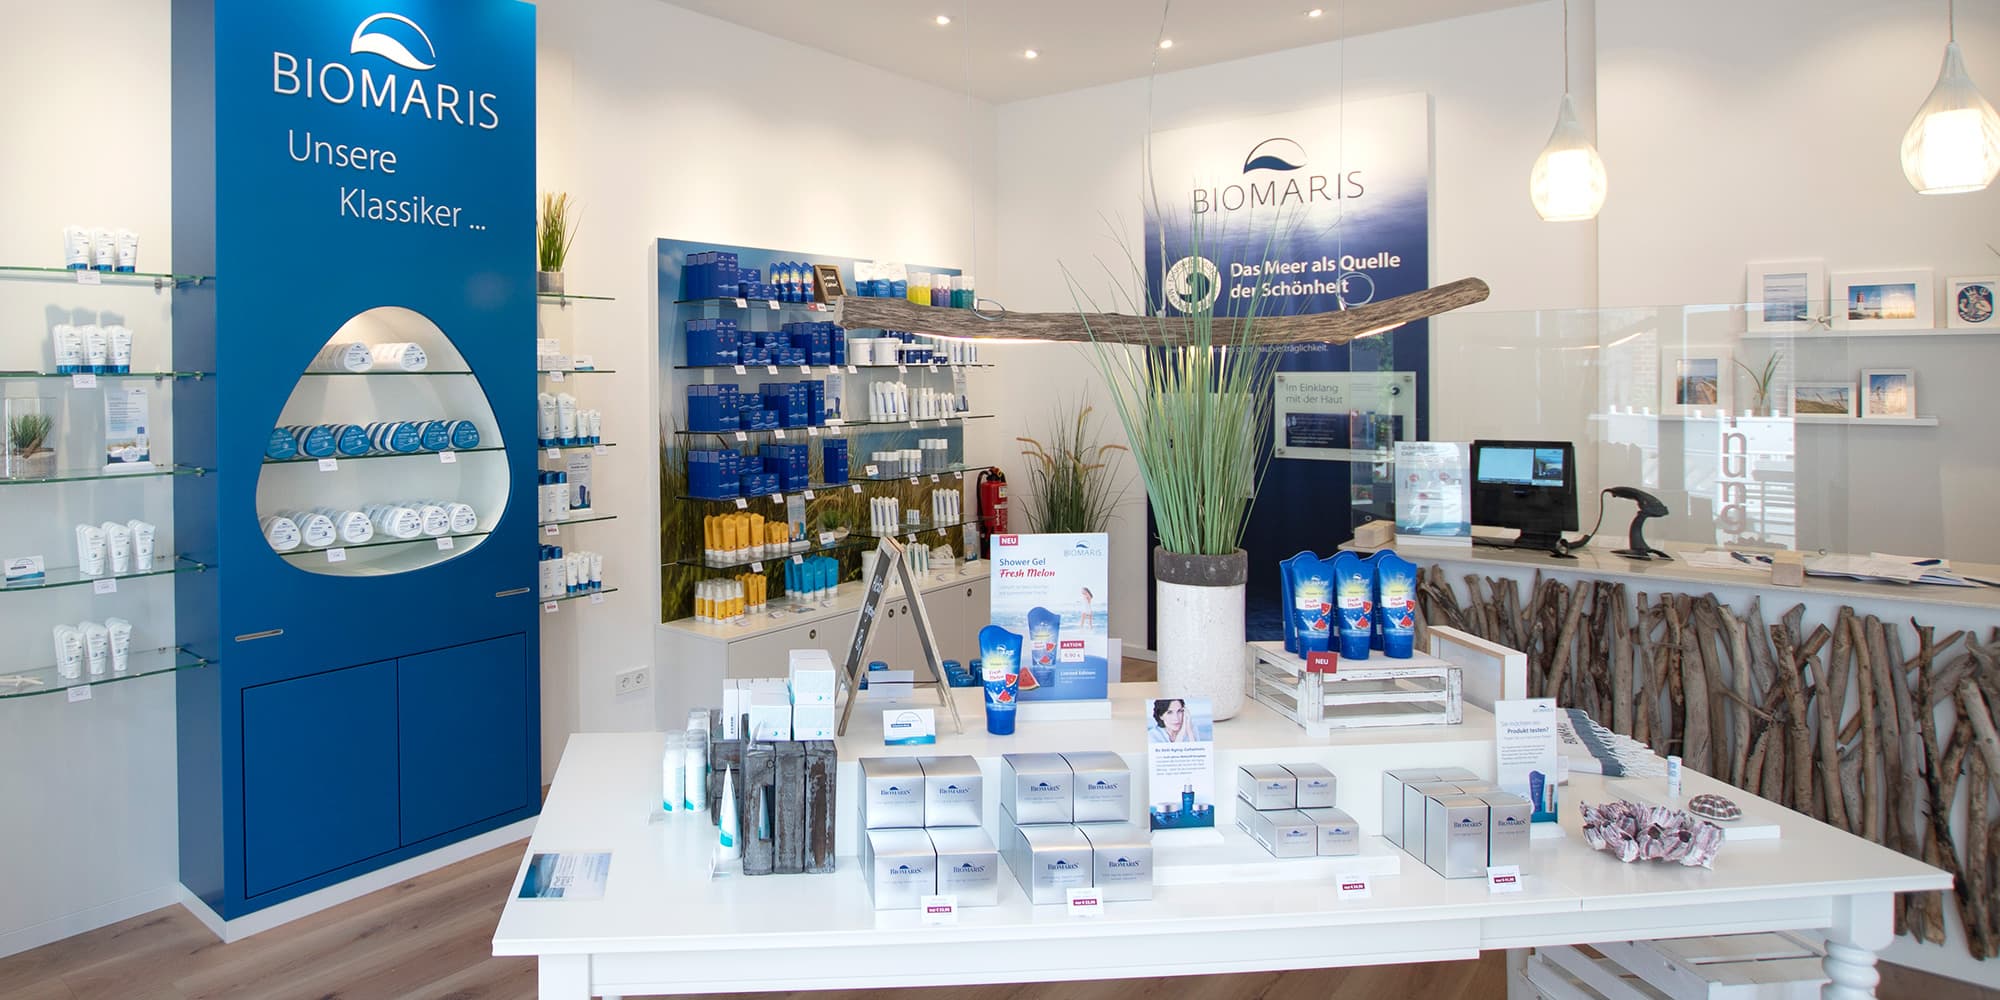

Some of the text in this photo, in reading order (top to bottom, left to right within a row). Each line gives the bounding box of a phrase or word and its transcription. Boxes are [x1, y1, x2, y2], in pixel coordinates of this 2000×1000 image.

[272, 51, 500, 131] BIOMARIS
[287, 130, 398, 174] Unsere
[1193, 171, 1365, 214] BIOMARIS
[339, 187, 463, 229] Klassiker
[1230, 252, 1401, 278] Das Meer als Quelle
[1230, 279, 1349, 298] der Schönheit
[1286, 383, 1339, 394] Im Einklang
[1286, 395, 1343, 404] mit der Haut
[1001, 537, 1017, 545] NEU
[1000, 558, 1046, 567] Shower Gel
[1000, 568, 1055, 578] Fresh Melon
